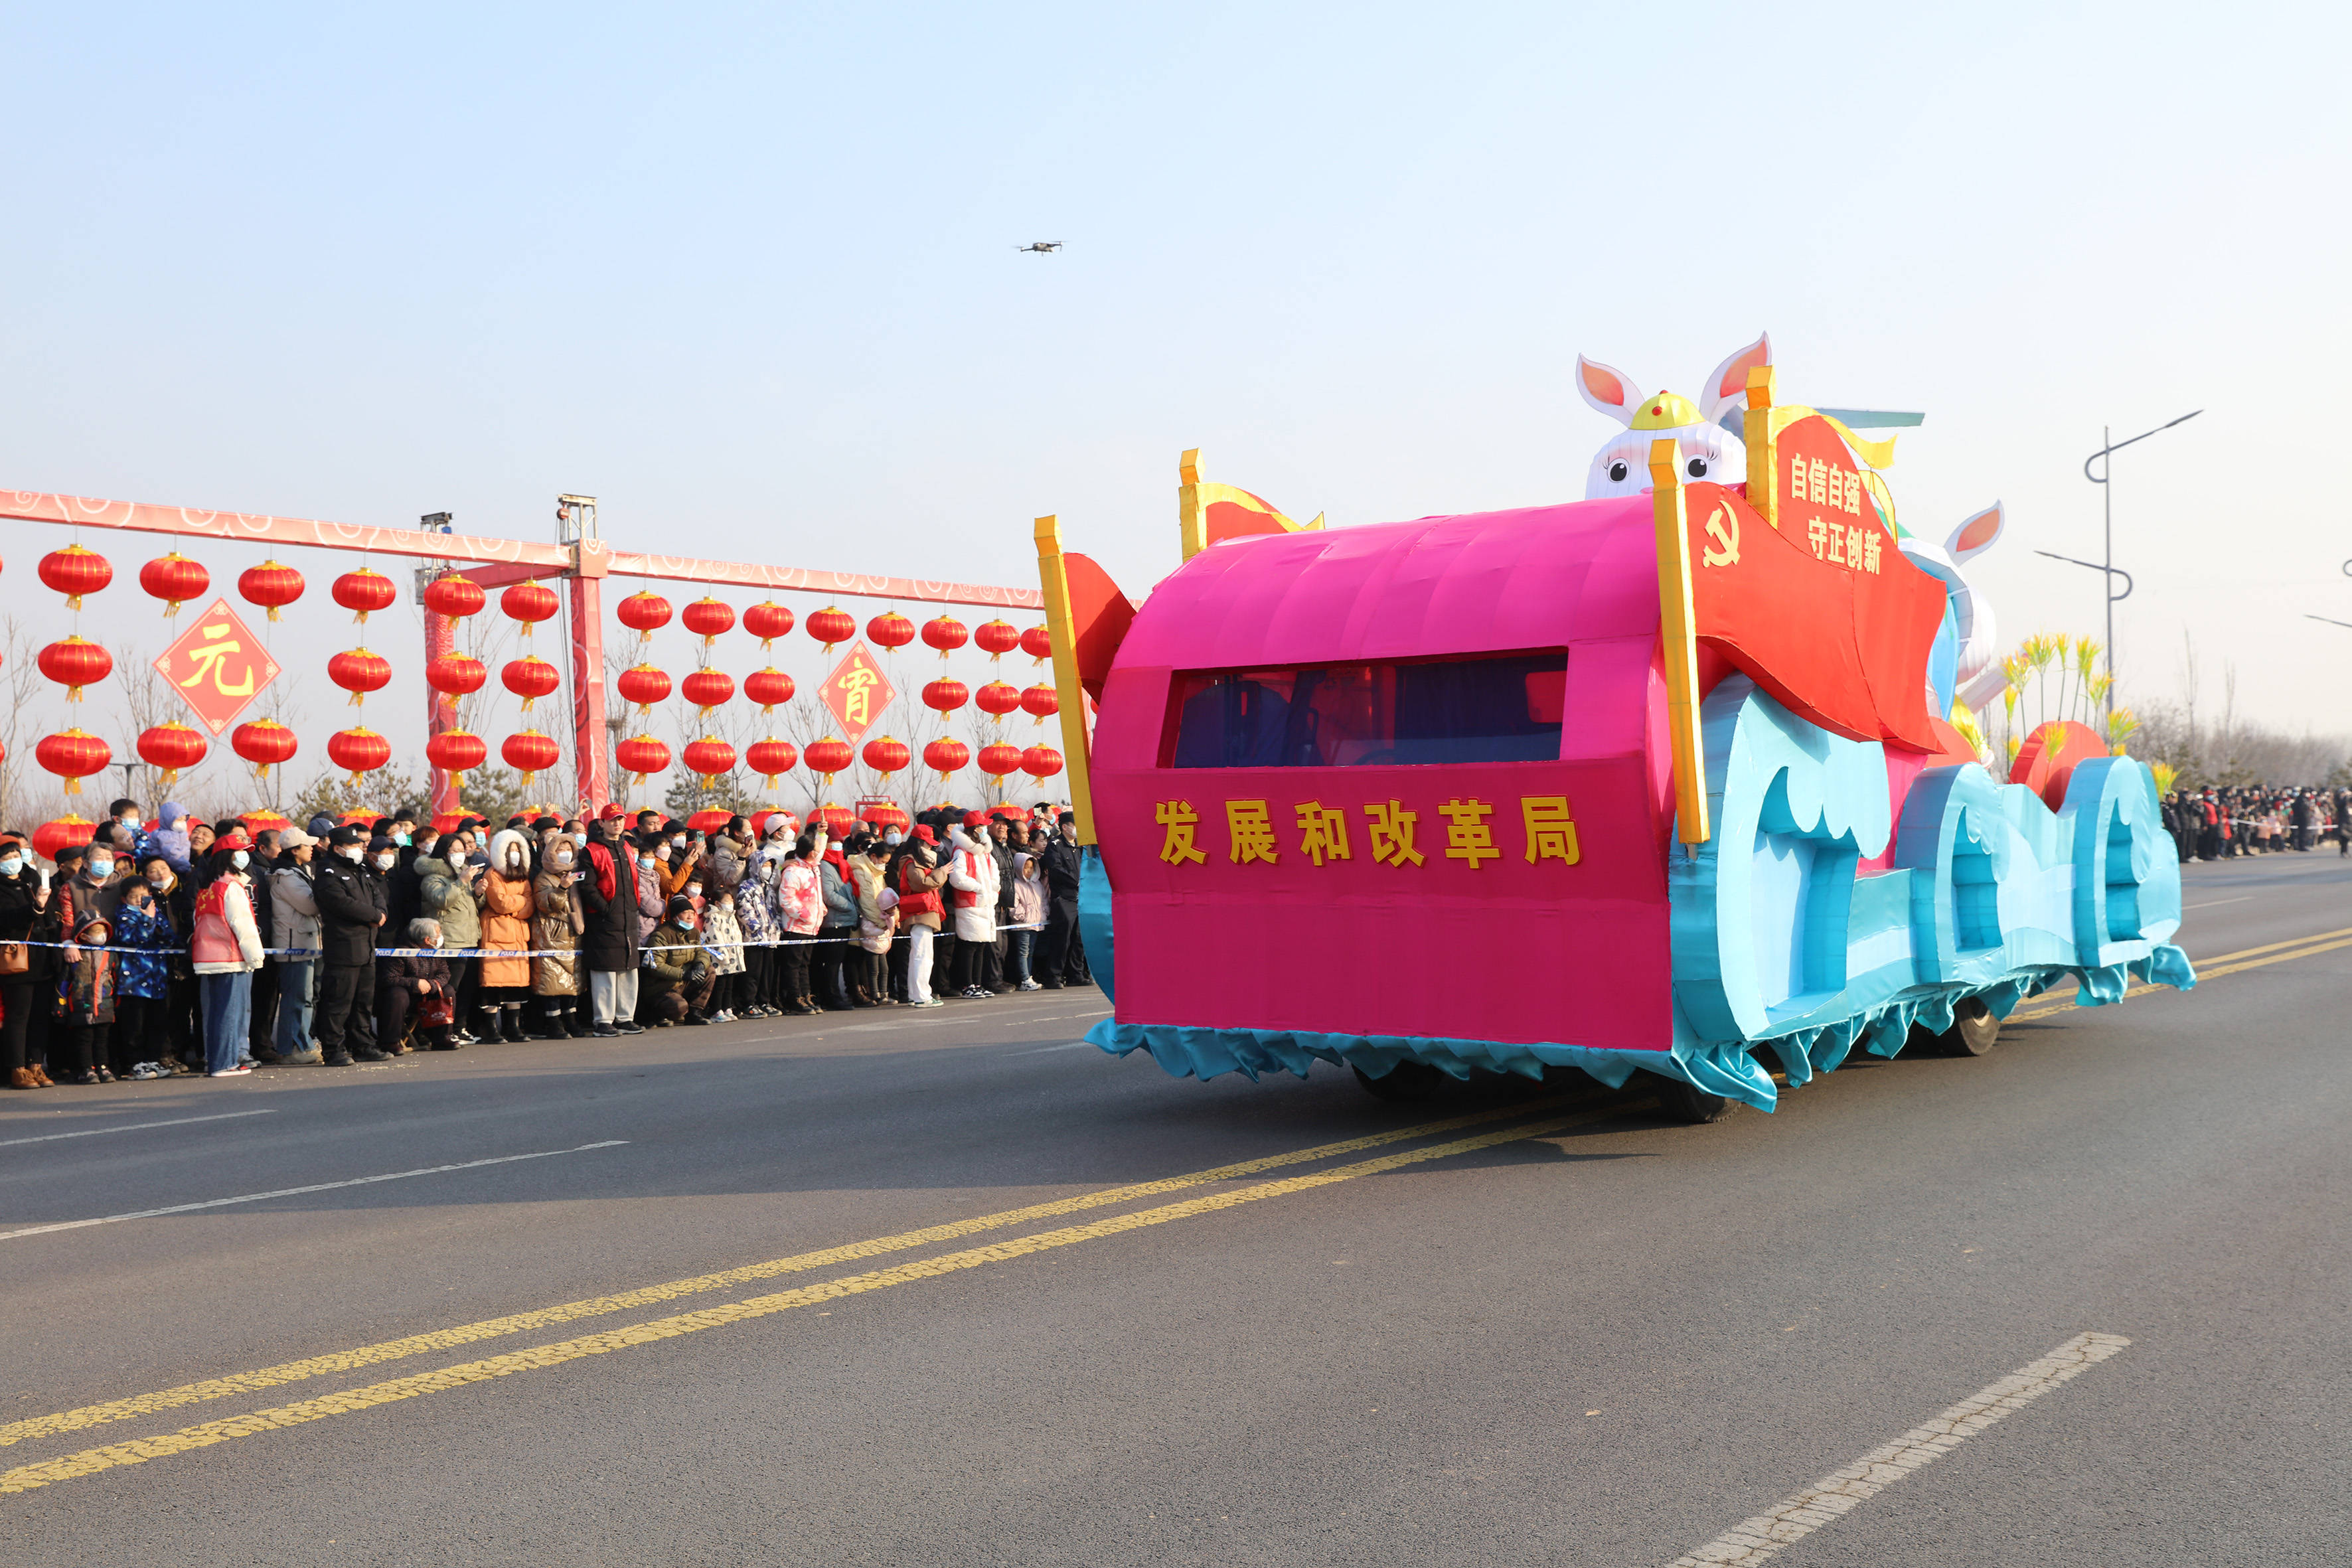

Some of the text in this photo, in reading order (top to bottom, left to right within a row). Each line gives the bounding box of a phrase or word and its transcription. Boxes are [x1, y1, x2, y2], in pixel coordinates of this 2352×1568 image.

[1792, 453, 1861, 516] 自信自强
[1808, 516, 1882, 575] 守正创新
[181, 623, 254, 696] 元
[838, 657, 878, 726] 宵
[1155, 796, 1582, 869] 发展和改革局
